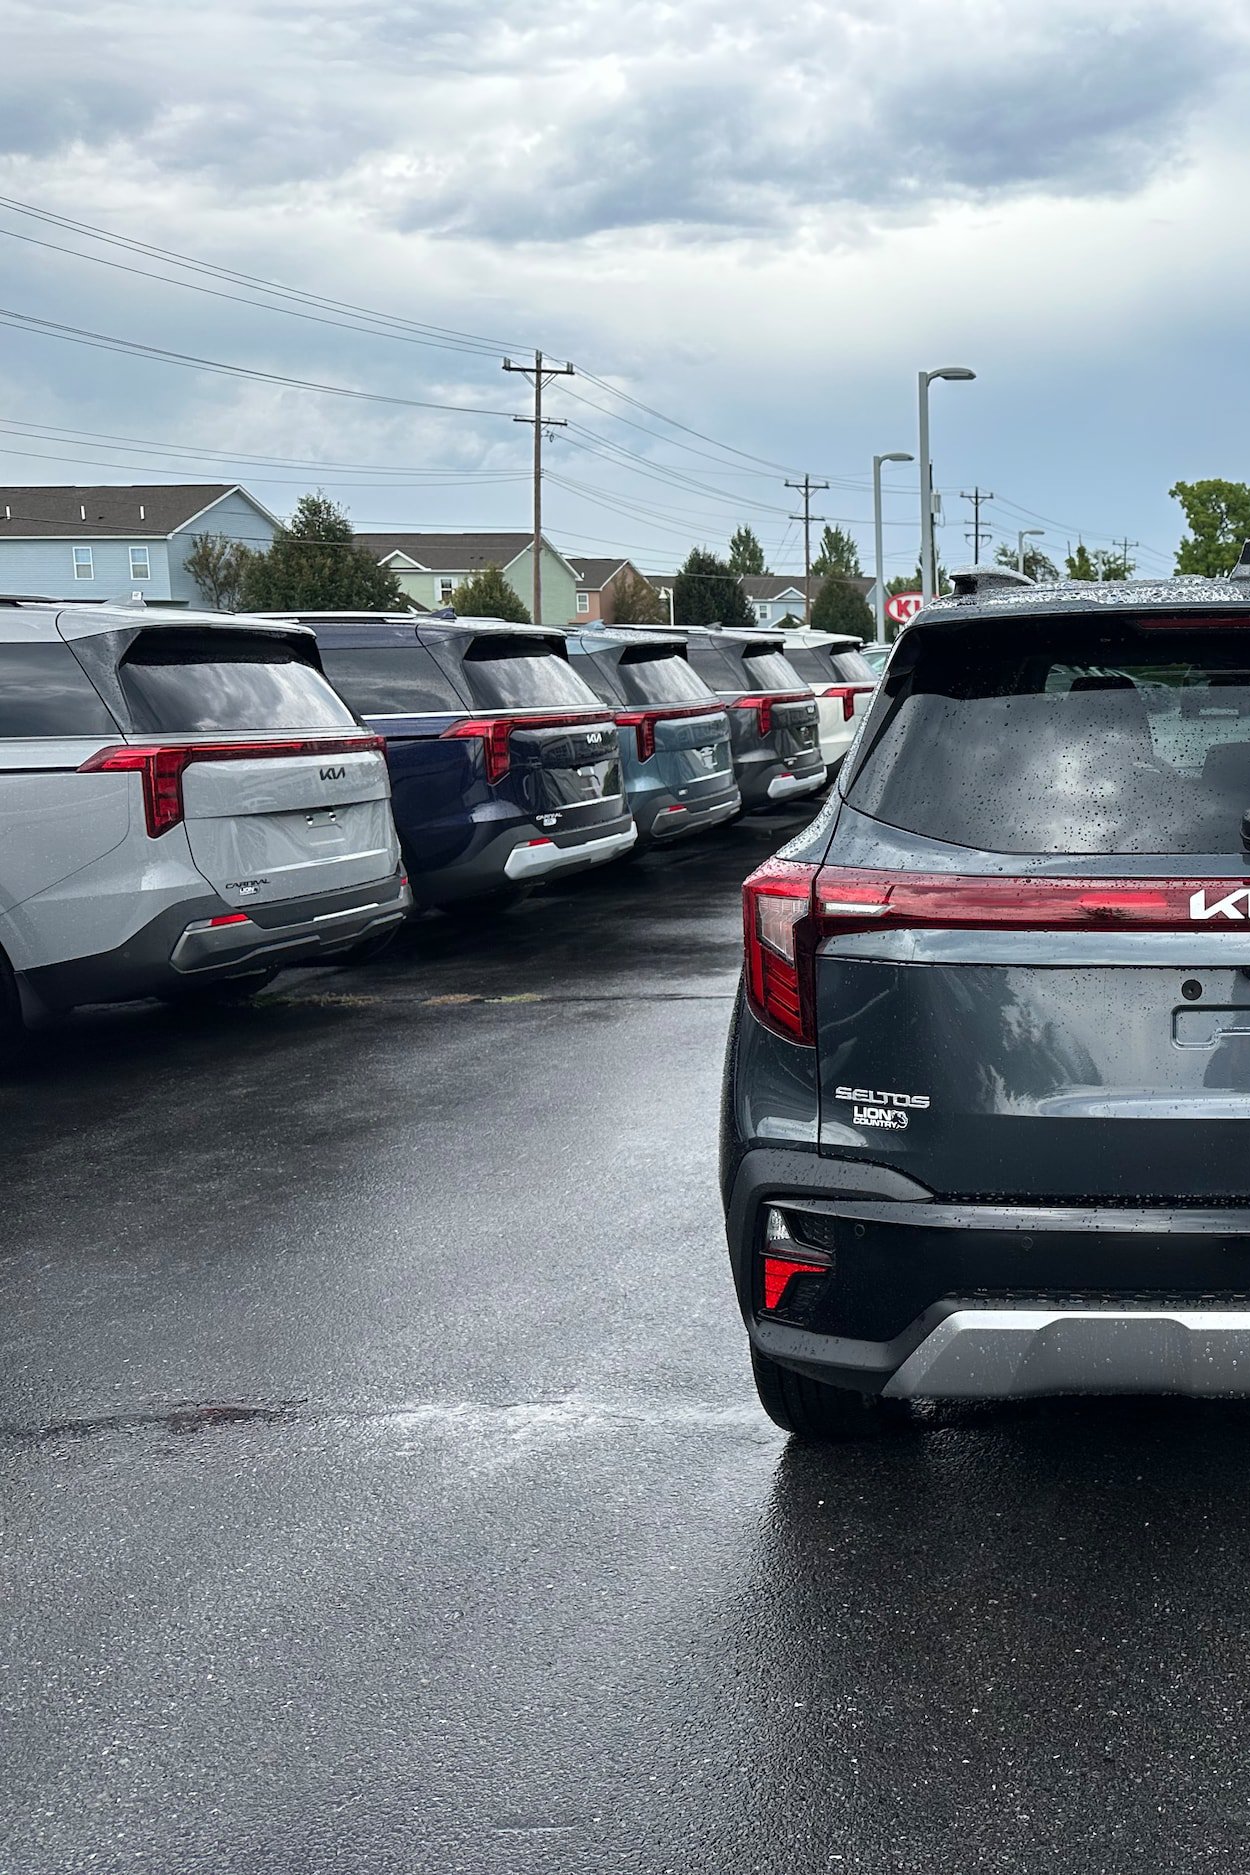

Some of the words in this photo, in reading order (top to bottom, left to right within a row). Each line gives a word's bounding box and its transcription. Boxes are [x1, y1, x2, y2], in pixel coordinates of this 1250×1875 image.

[835, 1086, 931, 1109] SELTOS
[853, 1105, 892, 1121] LION
[853, 1117, 899, 1129] COUNTRY
